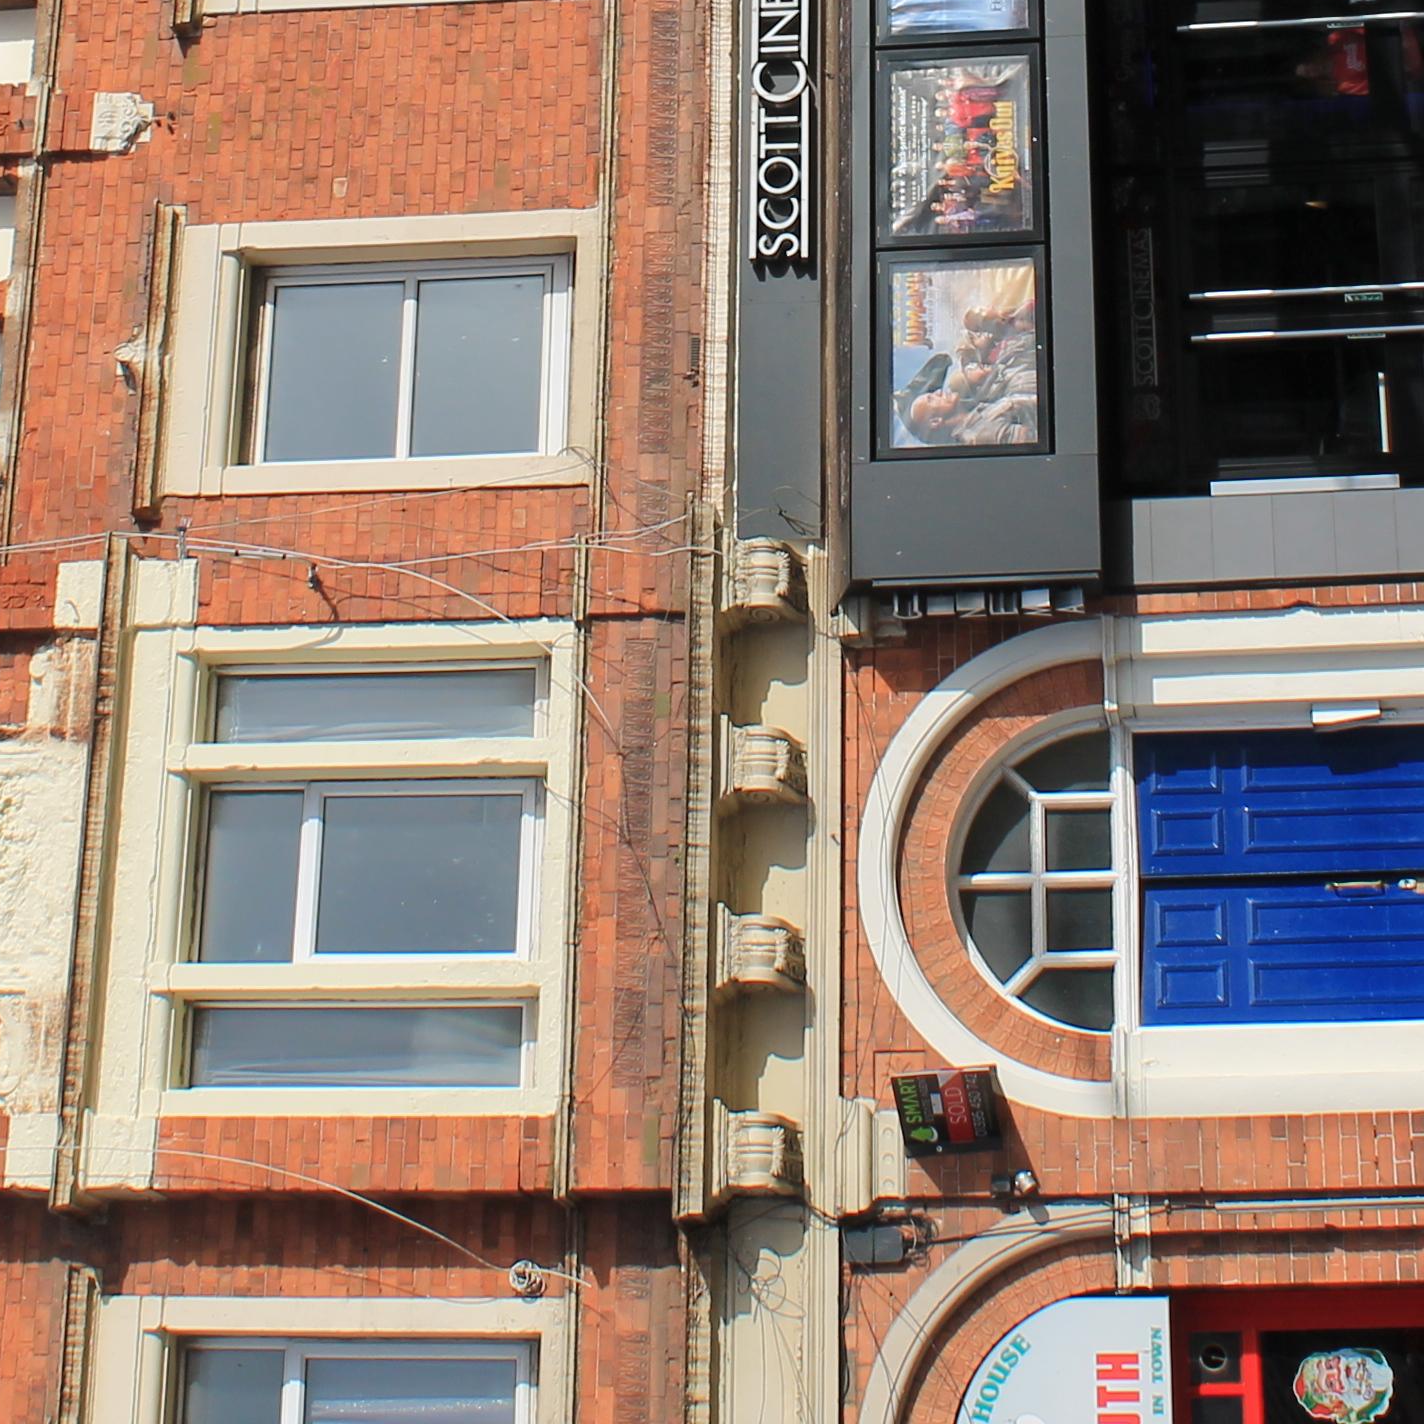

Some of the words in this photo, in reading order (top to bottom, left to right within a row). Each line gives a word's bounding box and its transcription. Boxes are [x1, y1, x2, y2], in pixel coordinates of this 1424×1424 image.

[988, 101, 1014, 130] Out
[988, 131, 1015, 193] Knives
[897, 1077, 923, 1124] SMART
[944, 1086, 968, 1124] SOLD
[1151, 1326, 1164, 1383] TOWN
[971, 1333, 1032, 1424] HOUSE
[1152, 1395, 1165, 1416] IN
